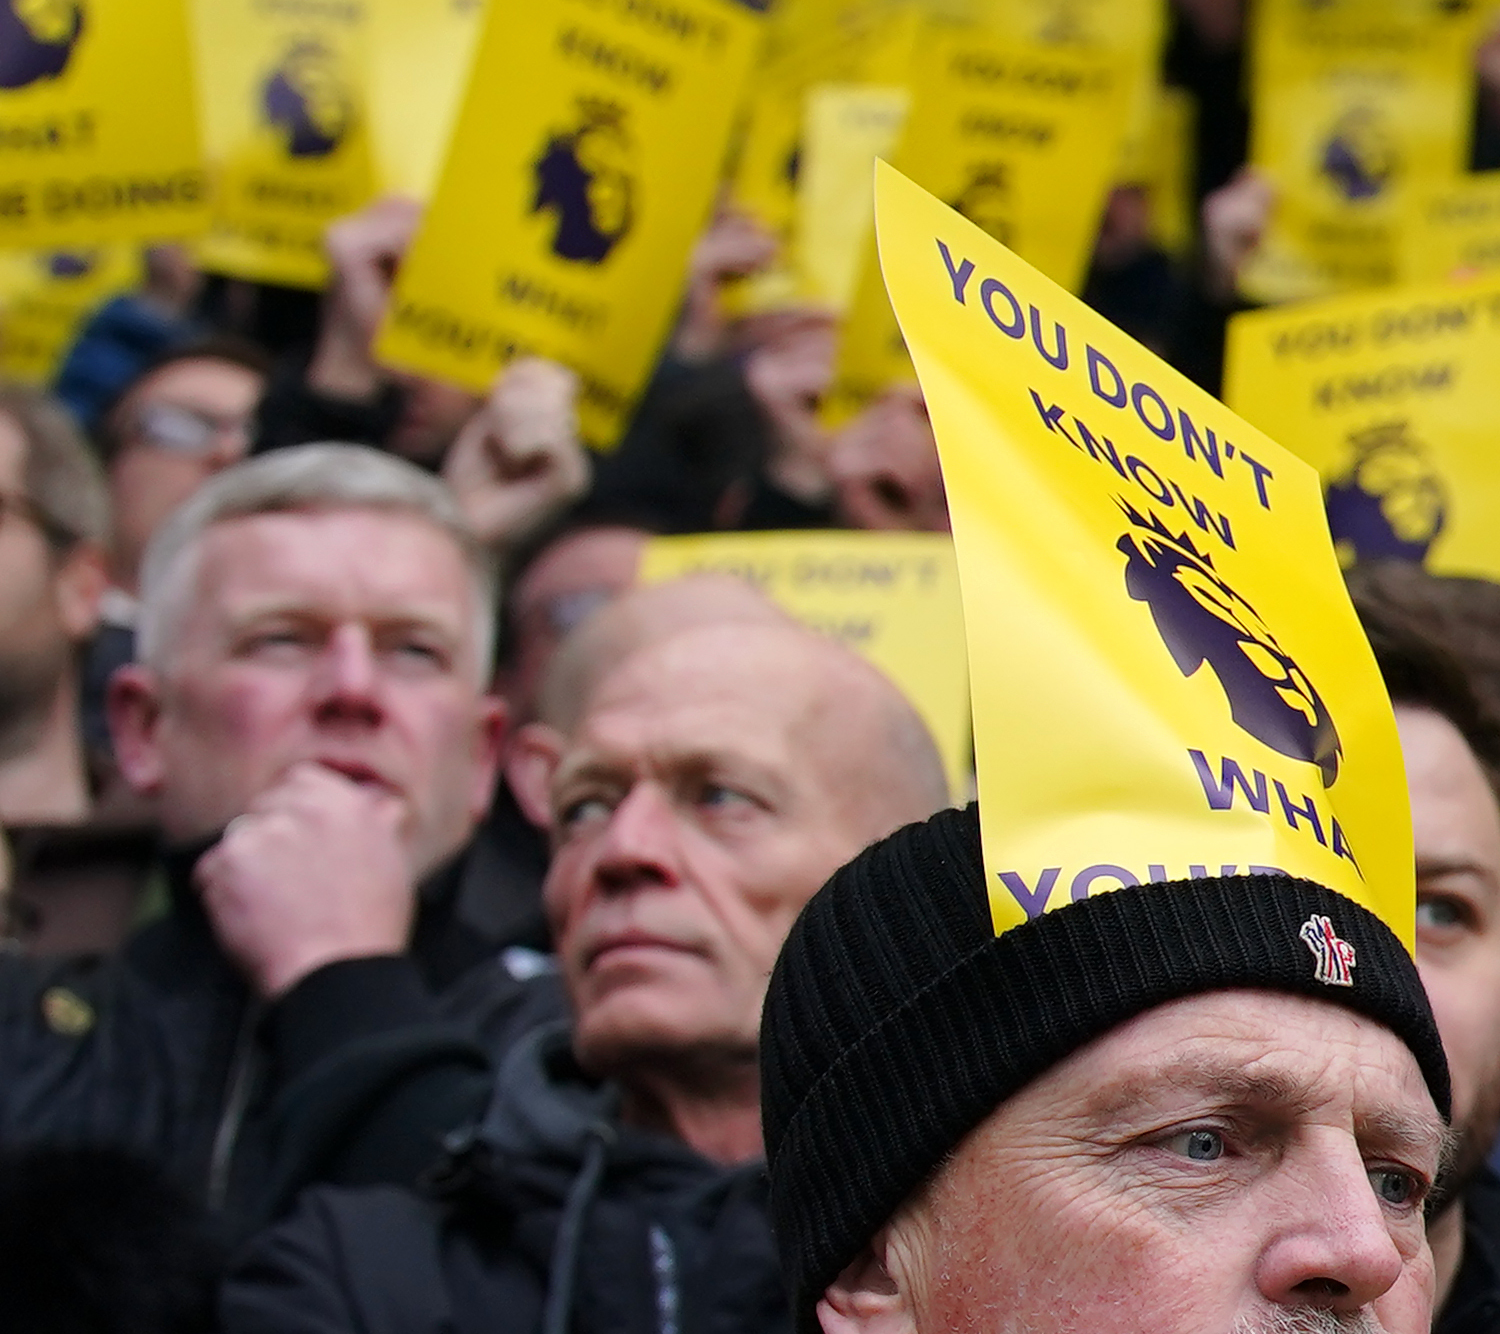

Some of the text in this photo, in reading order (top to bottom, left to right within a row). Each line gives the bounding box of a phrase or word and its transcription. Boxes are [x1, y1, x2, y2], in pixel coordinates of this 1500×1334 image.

[934, 236, 1275, 512] YOU DON'T
[1028, 386, 1236, 551] KNOW
[1187, 748, 1366, 883] WHA
